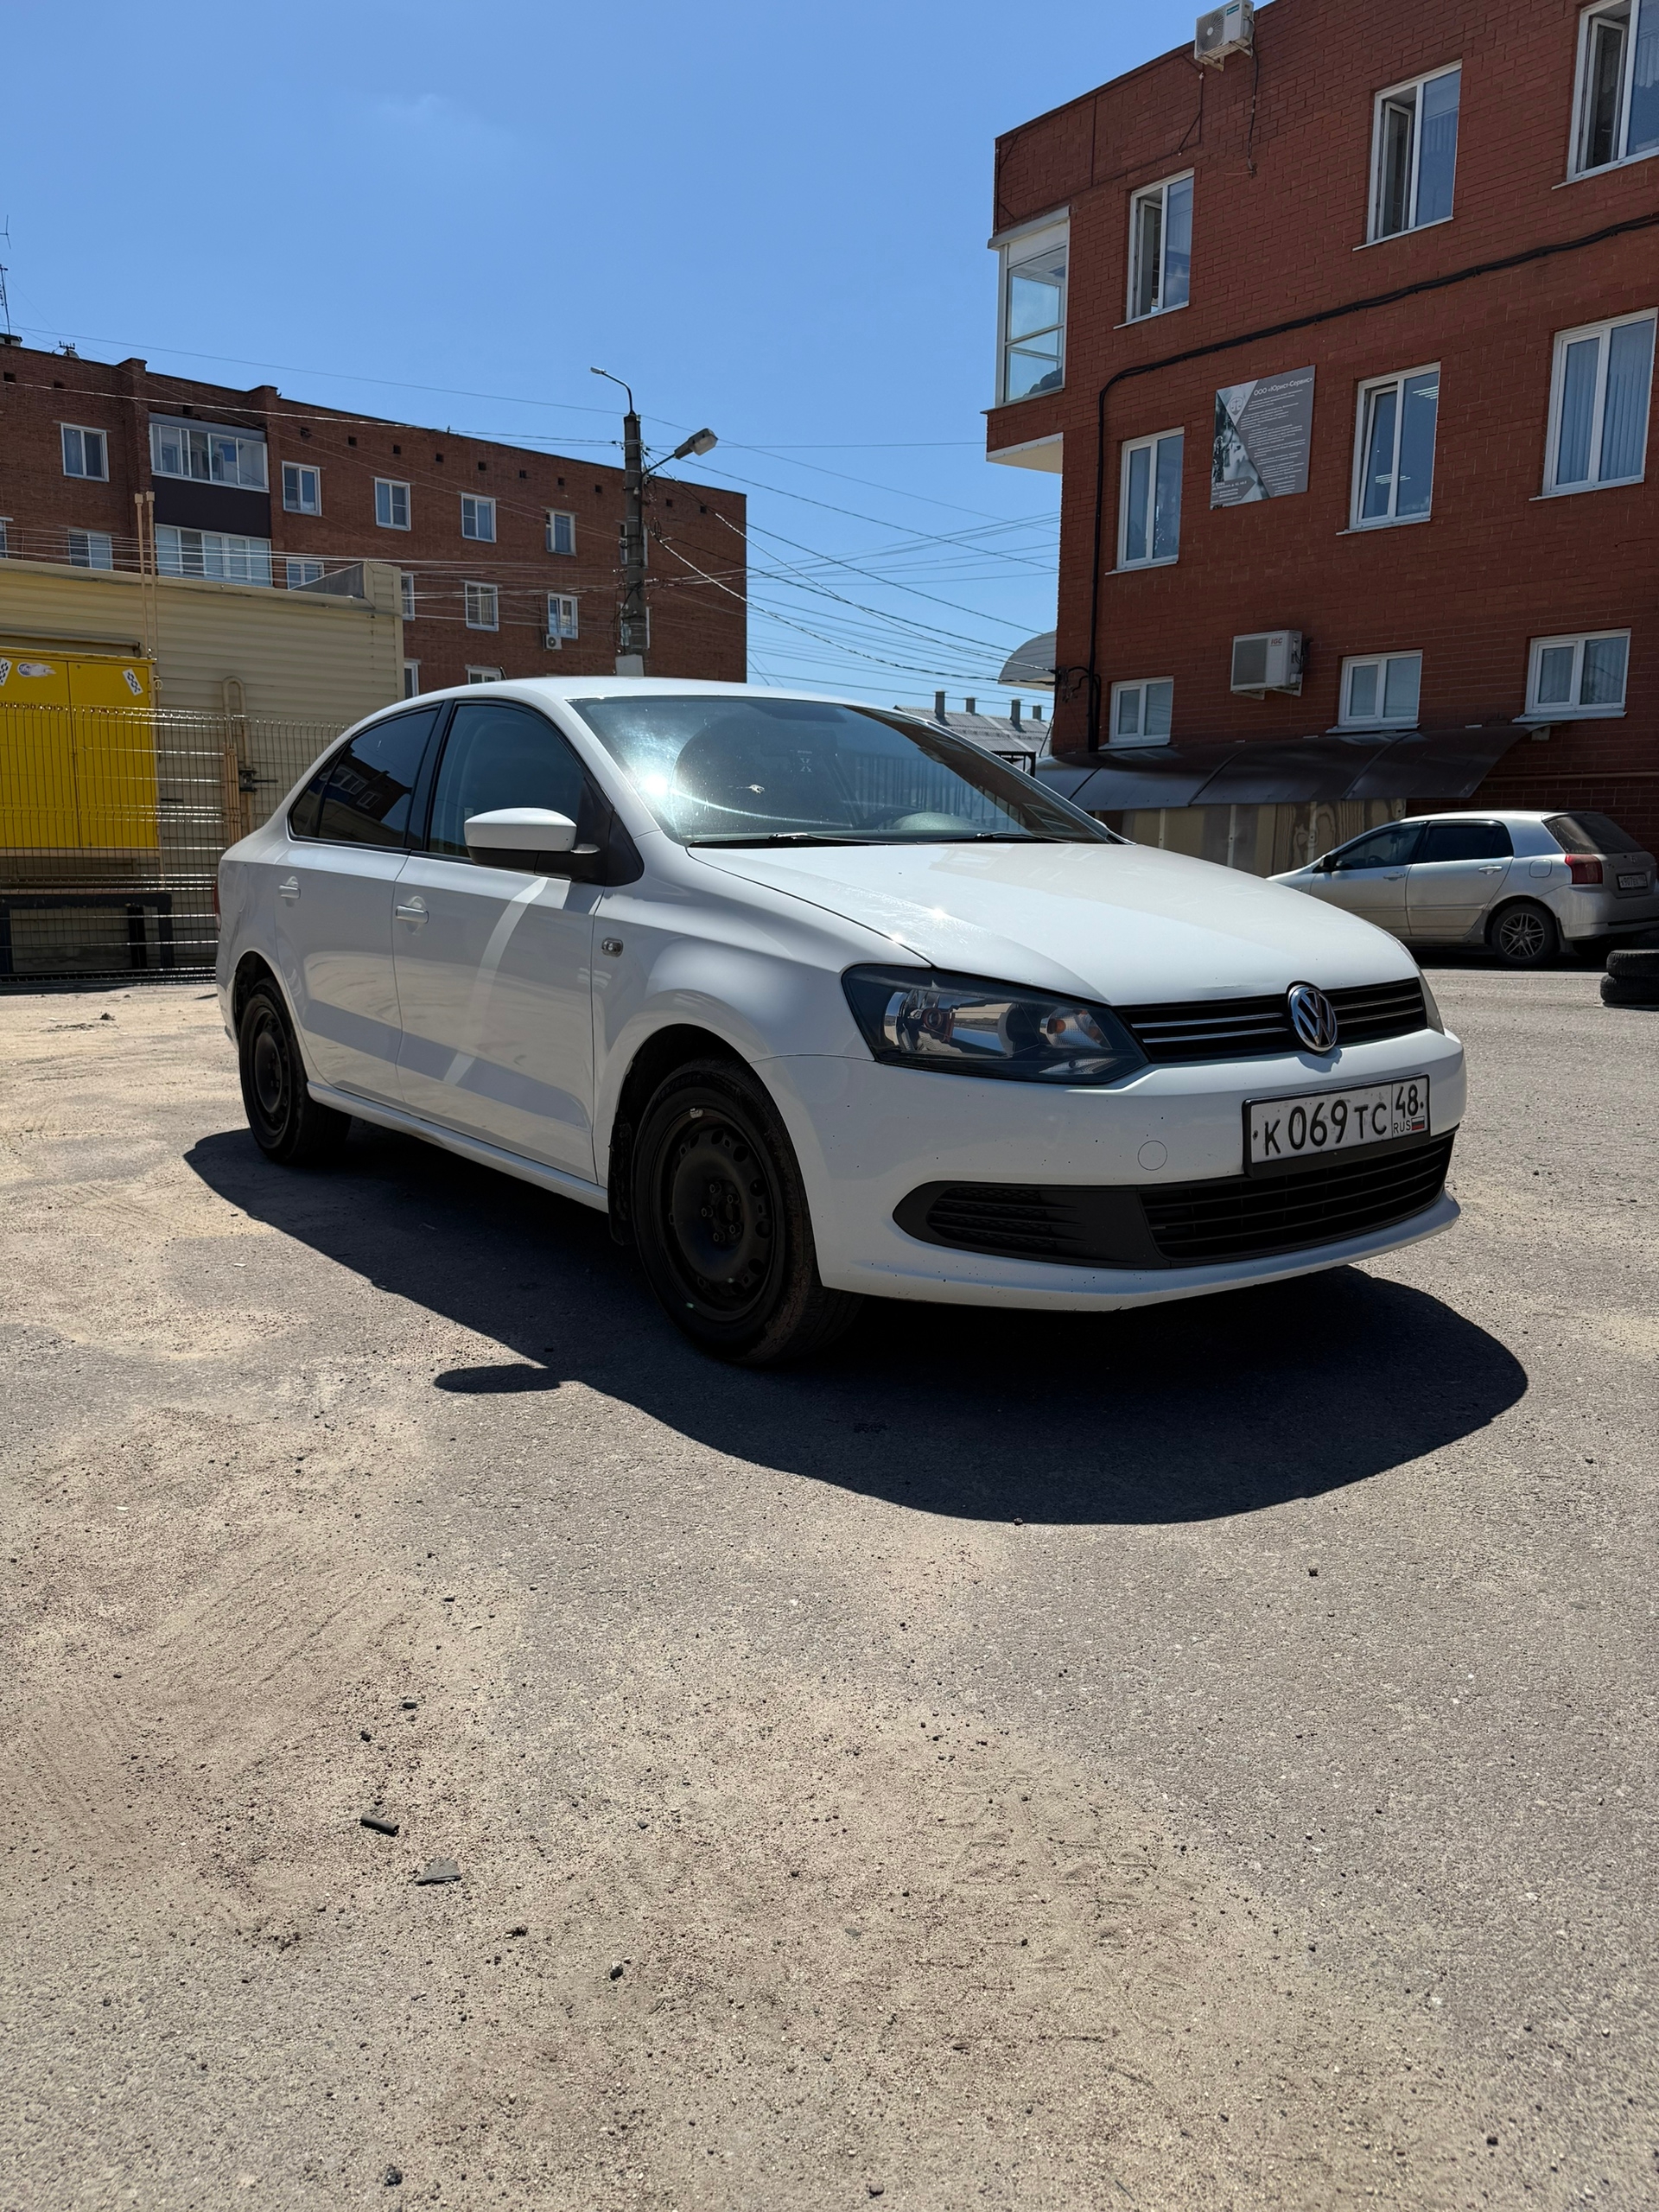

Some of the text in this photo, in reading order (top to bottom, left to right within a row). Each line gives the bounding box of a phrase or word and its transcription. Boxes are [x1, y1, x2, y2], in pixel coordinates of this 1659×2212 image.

[1254, 387, 1268, 396] ООО
[1265, 1084, 1420, 1156] К069ТС 48
[1393, 1120, 1411, 1135] RUS
